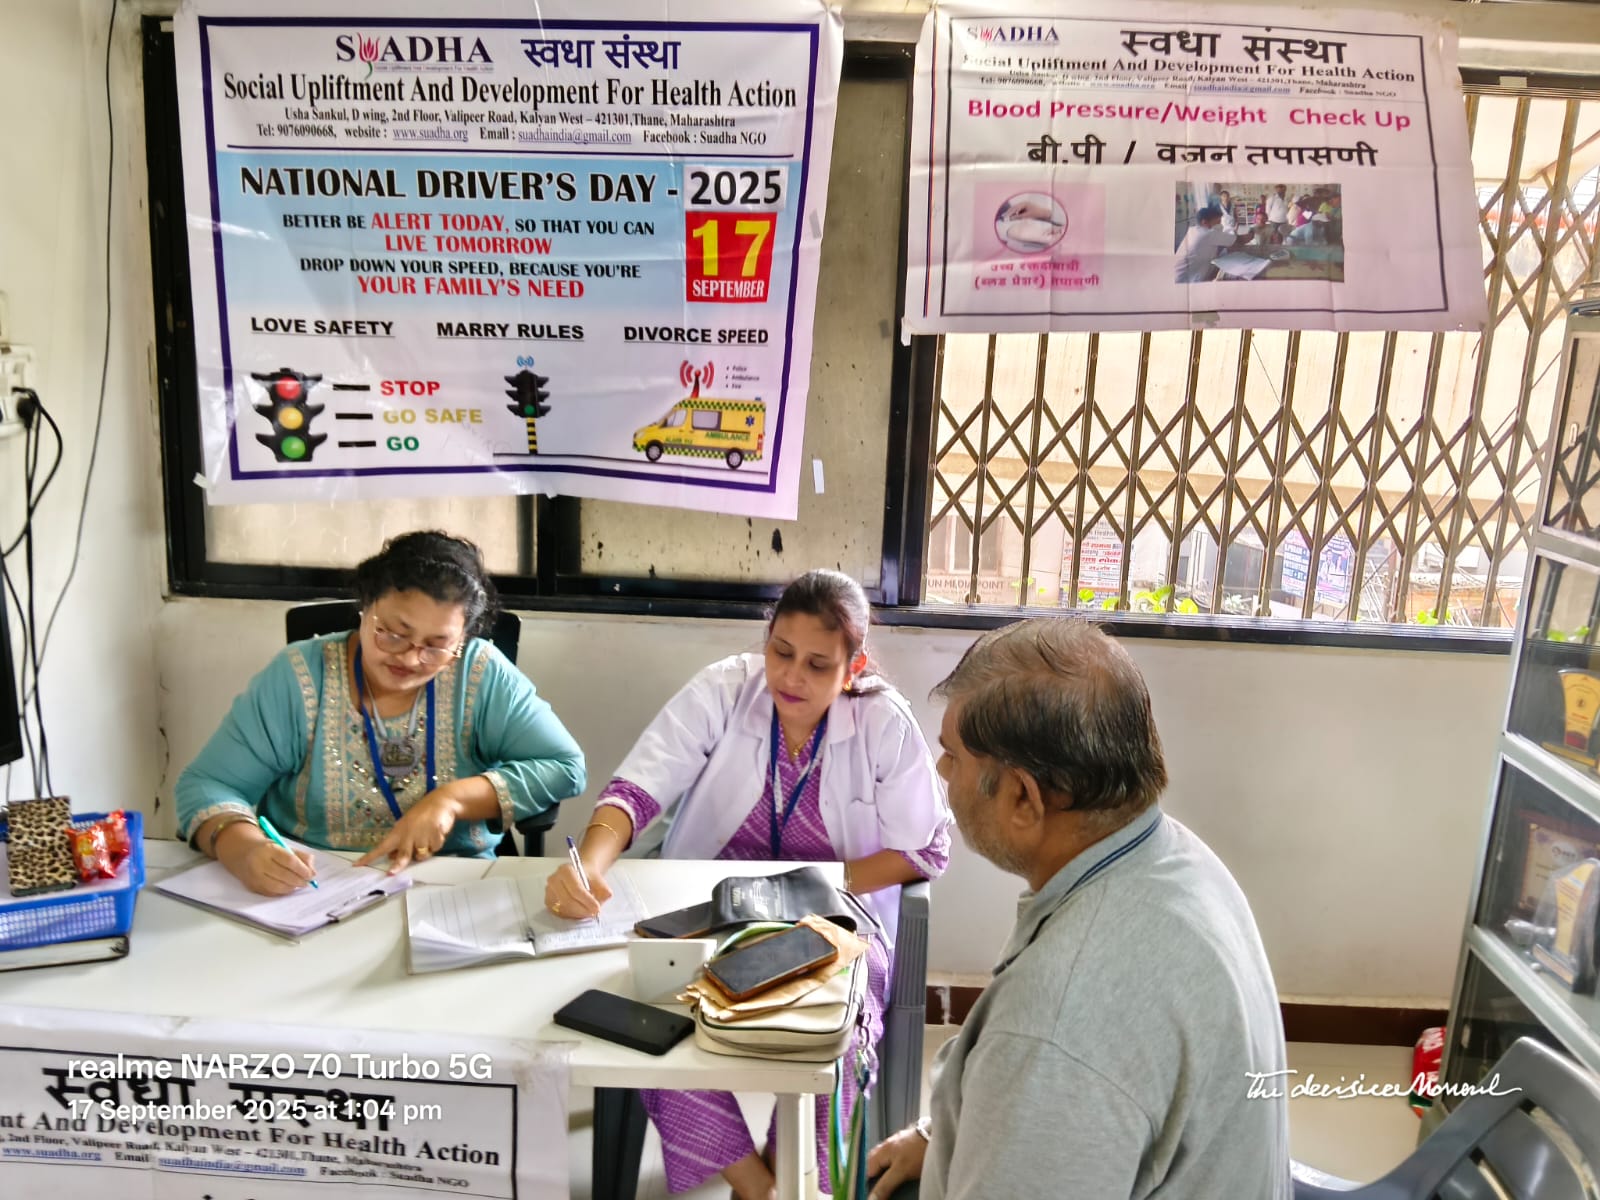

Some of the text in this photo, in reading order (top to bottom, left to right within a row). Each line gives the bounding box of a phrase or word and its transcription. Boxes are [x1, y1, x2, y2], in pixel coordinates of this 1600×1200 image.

[521, 33, 681, 69] स्वधा संस्था
[1120, 26, 1347, 64] स्वधा संस्था
[1018, 54, 1107, 72] Upliftment
[1112, 58, 1147, 72] And
[1154, 59, 1259, 76] Development
[1266, 64, 1295, 76] For
[1302, 65, 1356, 78] Health
[1362, 67, 1415, 82] Action
[223, 73, 796, 111] Social Upliftment And Development For Health Action
[285, 107, 309, 121] Usha
[312, 107, 349, 122] Sankul,
[352, 108, 360, 121] D
[362, 109, 388, 124] wing,
[391, 109, 410, 122] 2nd
[413, 109, 442, 124] Floor,
[445, 110, 485, 126] Valipeer
[487, 110, 517, 125] Road,
[520, 111, 556, 128] Kalyan
[559, 111, 583, 125] West
[670, 113, 736, 128] Maharashtra
[968, 99, 1411, 131] Blood Pressure/Weight Check Up
[256, 123, 275, 137] Tel:
[277, 124, 337, 139] 9076090668,
[345, 125, 379, 139] website
[393, 126, 469, 142] www.suadha.org
[480, 127, 510, 141] Email
[518, 128, 632, 145] suadhaindia@gmail.com
[643, 130, 690, 144] Facebook
[699, 131, 737, 145] Suadha
[740, 133, 767, 146] NGO
[1026, 134, 1106, 164] बी.पी
[1156, 142, 1237, 164] वजन
[1245, 141, 1378, 167] तपासणी
[241, 167, 406, 198] NATIONAL
[417, 170, 577, 202] DRIVER'S
[590, 173, 656, 203] DAY
[690, 170, 781, 205] 2025
[283, 212, 655, 235] BETTER BE ALERT TODAY, SO THAT YOU CAN
[385, 235, 552, 255] LIVE TOMORROW
[692, 219, 771, 278] 17
[301, 258, 641, 278] DROP DOWN YOUR SPEED, BECAUSE YOU'RE
[357, 275, 584, 298] YOUR FAMILY'S NEED
[692, 280, 765, 299] SEPTEMBER
[251, 317, 394, 336] LOVE SAFETY
[437, 322, 584, 340] MARRY RULES
[624, 326, 769, 345] DIVORCE SPEED
[380, 380, 440, 396] STOP
[383, 408, 483, 424] GO SAFE
[386, 436, 420, 451] GO
[705, 431, 750, 442] AMBULANCE
[42, 1067, 195, 1115] स्वधा
[34, 1111, 87, 1132] And
[97, 1114, 261, 1142] Development
[268, 1127, 314, 1146] For
[322, 1131, 406, 1157] Health
[416, 1140, 500, 1166] Action
[114, 1151, 150, 1163] Email
